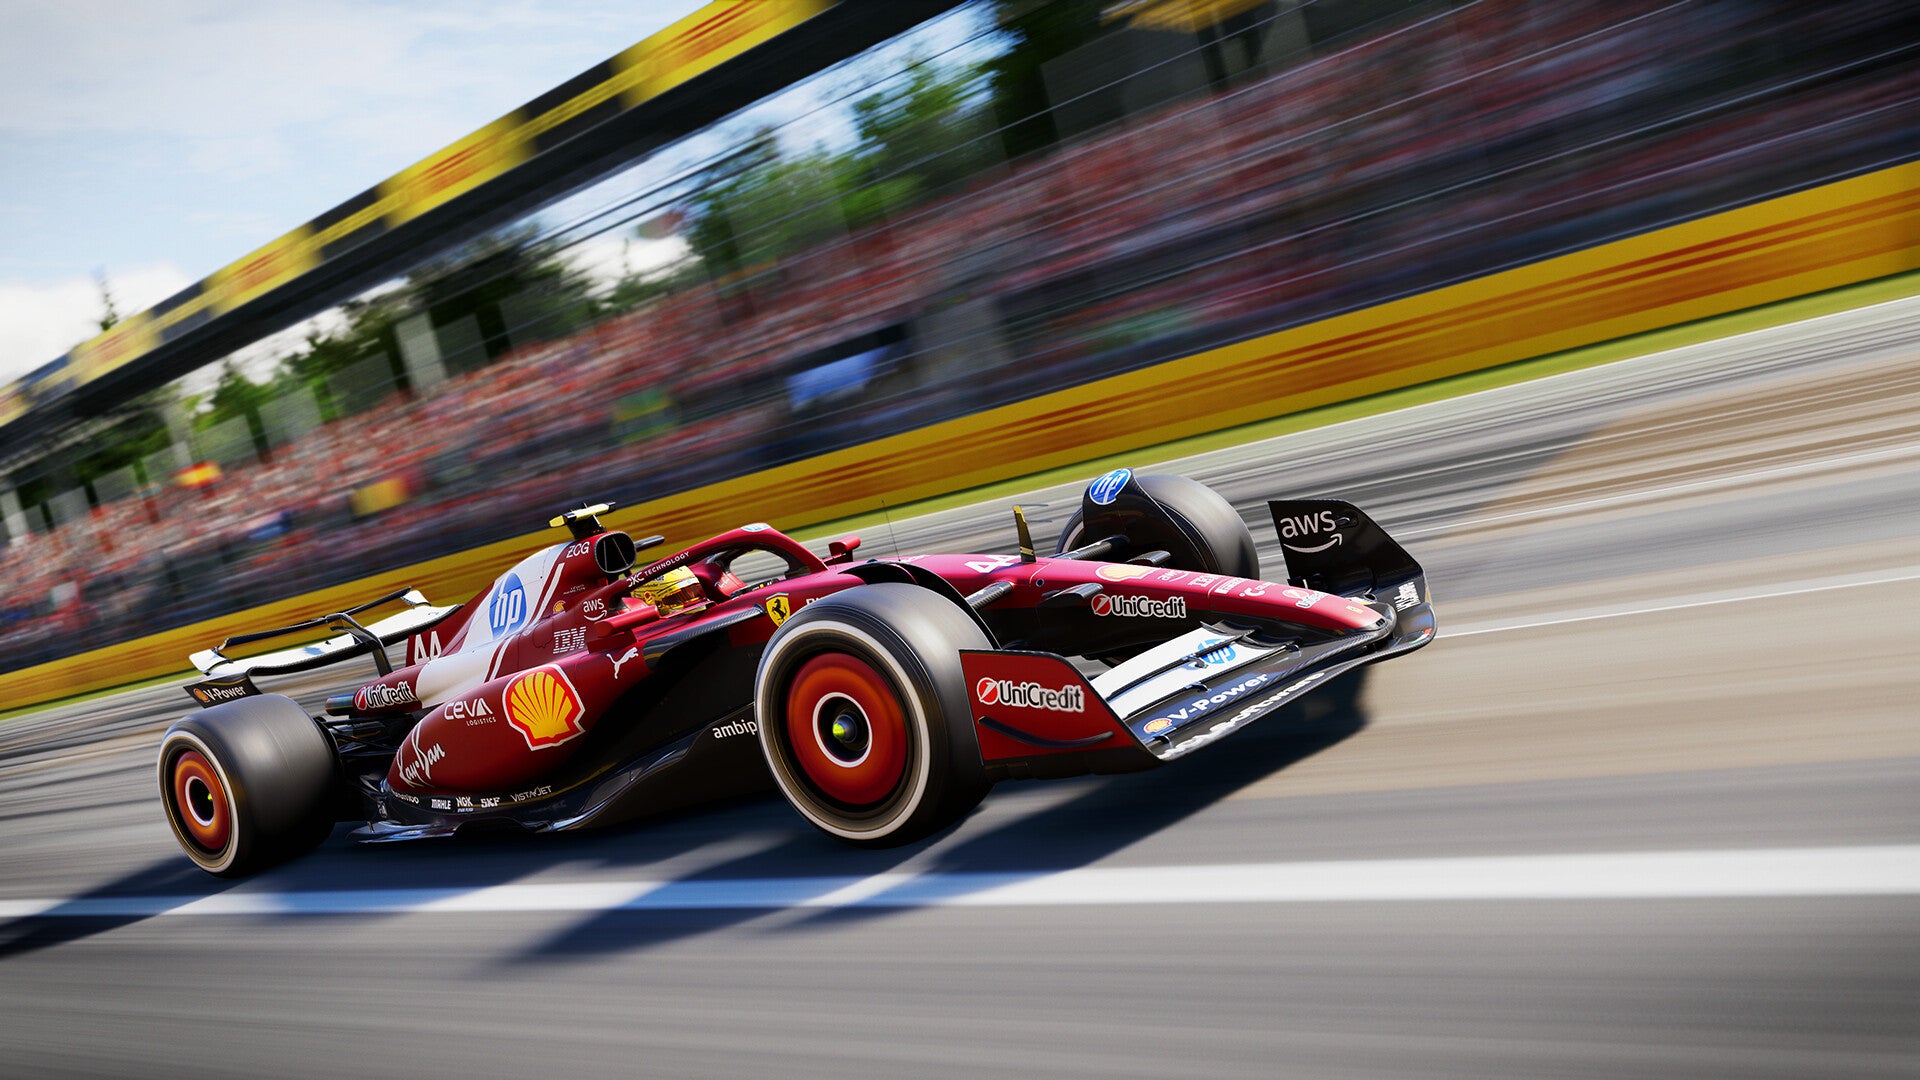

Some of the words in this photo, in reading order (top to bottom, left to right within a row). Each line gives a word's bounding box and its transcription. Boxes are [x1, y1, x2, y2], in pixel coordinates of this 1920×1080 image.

[1280, 511, 1336, 538] aws
[566, 541, 590, 558] ZCG
[644, 551, 690, 576] TECHNOLOGY
[490, 573, 526, 638] hp
[583, 598, 605, 613] aws
[1110, 596, 1186, 618] UniCredit
[552, 626, 587, 654] IBM
[203, 686, 246, 700] V-Power
[365, 681, 417, 708] UniCredit
[999, 681, 1083, 712] UniCredit
[1168, 674, 1268, 720] V-Power
[466, 717, 497, 726] LOGISTICS
[713, 719, 757, 738] ambip
[431, 799, 451, 810] MAHLE
[456, 796, 473, 807] NGK
[480, 797, 500, 808] SKF
